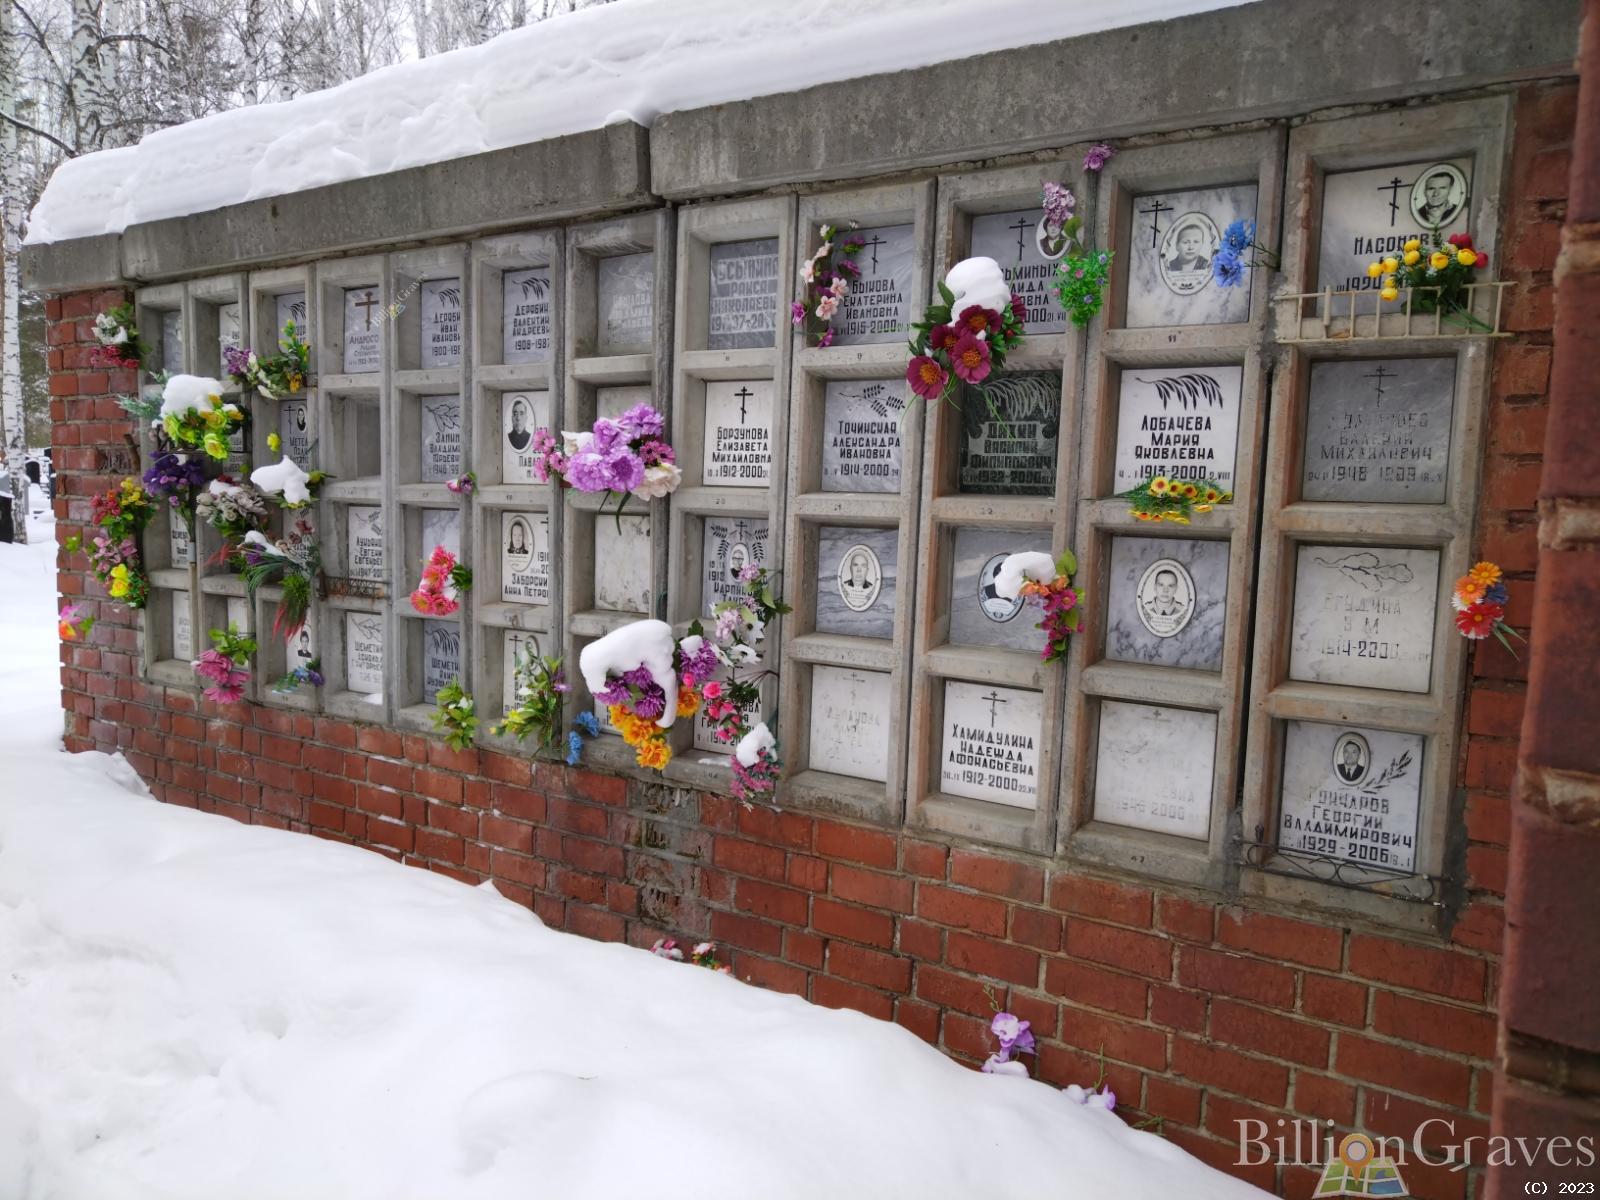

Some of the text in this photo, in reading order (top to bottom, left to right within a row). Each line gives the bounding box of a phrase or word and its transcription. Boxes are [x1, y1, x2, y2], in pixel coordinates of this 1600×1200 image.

[852, 278, 895, 295] БЫКОВА
[843, 292, 903, 308] ЕКАТЕРИНА
[846, 306, 899, 321] ИВАНОВНА
[839, 420, 897, 435] ТОЧИНСКАЯ
[1141, 415, 1212, 432] ЛОБАЧЕВА
[717, 426, 769, 441] БОРЗУНОВА
[1151, 431, 1200, 447] МАРИЯ
[716, 440, 768, 452] ЕЛИЗАВЕТА
[832, 436, 901, 448] АЛЕКСАНДРА
[840, 448, 892, 460] ИВАНОВНА
[1135, 445, 1215, 460] ЯКОВЛЕВНА
[504, 585, 522, 596] АННА
[952, 722, 1033, 751] ХАМИДУЛИНА
[960, 740, 1023, 763] НАДЕЖДА
[949, 749, 1034, 777] АФОНАСЬЕВНА
[962, 769, 1018, 792] 1912-2000
[1284, 813, 1412, 848] ВЛАДИМИРОВИЧ
